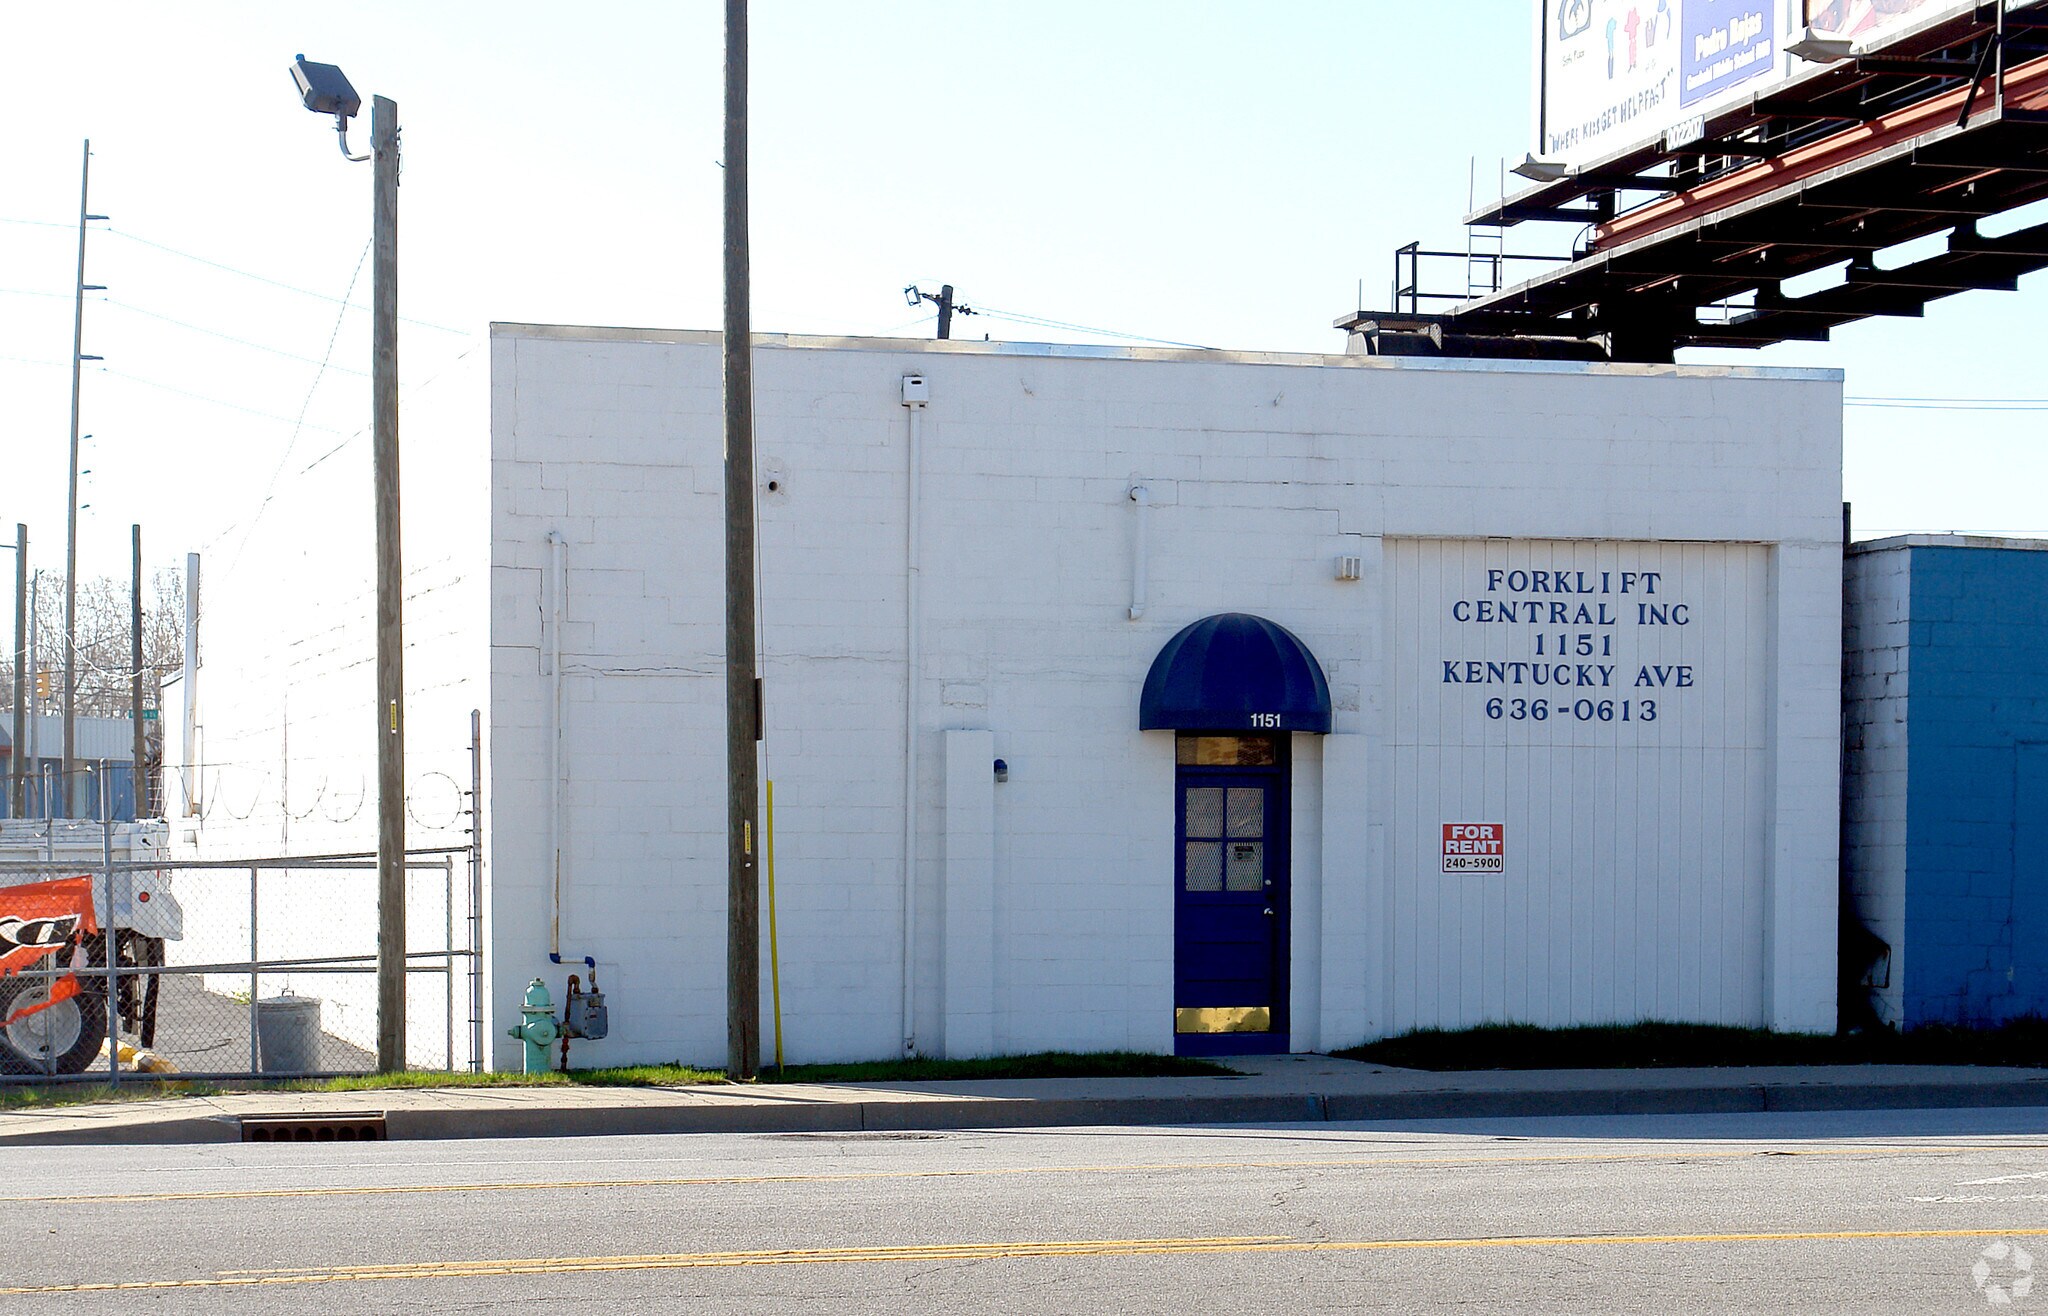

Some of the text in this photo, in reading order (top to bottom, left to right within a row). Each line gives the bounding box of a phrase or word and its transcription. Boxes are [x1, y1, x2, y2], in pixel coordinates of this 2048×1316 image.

[1601, 105, 1617, 131] GET
[1487, 569, 1661, 594] FORKLIFT
[1453, 600, 1690, 625] CENTRAL INC
[1536, 633, 1611, 656] 1151
[1442, 661, 1694, 687] KENTUCKY AVE
[1250, 713, 1280, 728] 1151
[1486, 698, 1657, 721] 636-0613
[1452, 825, 1494, 839] FOR
[1445, 840, 1500, 853] RENT
[1446, 858, 1500, 868] 240-5900
